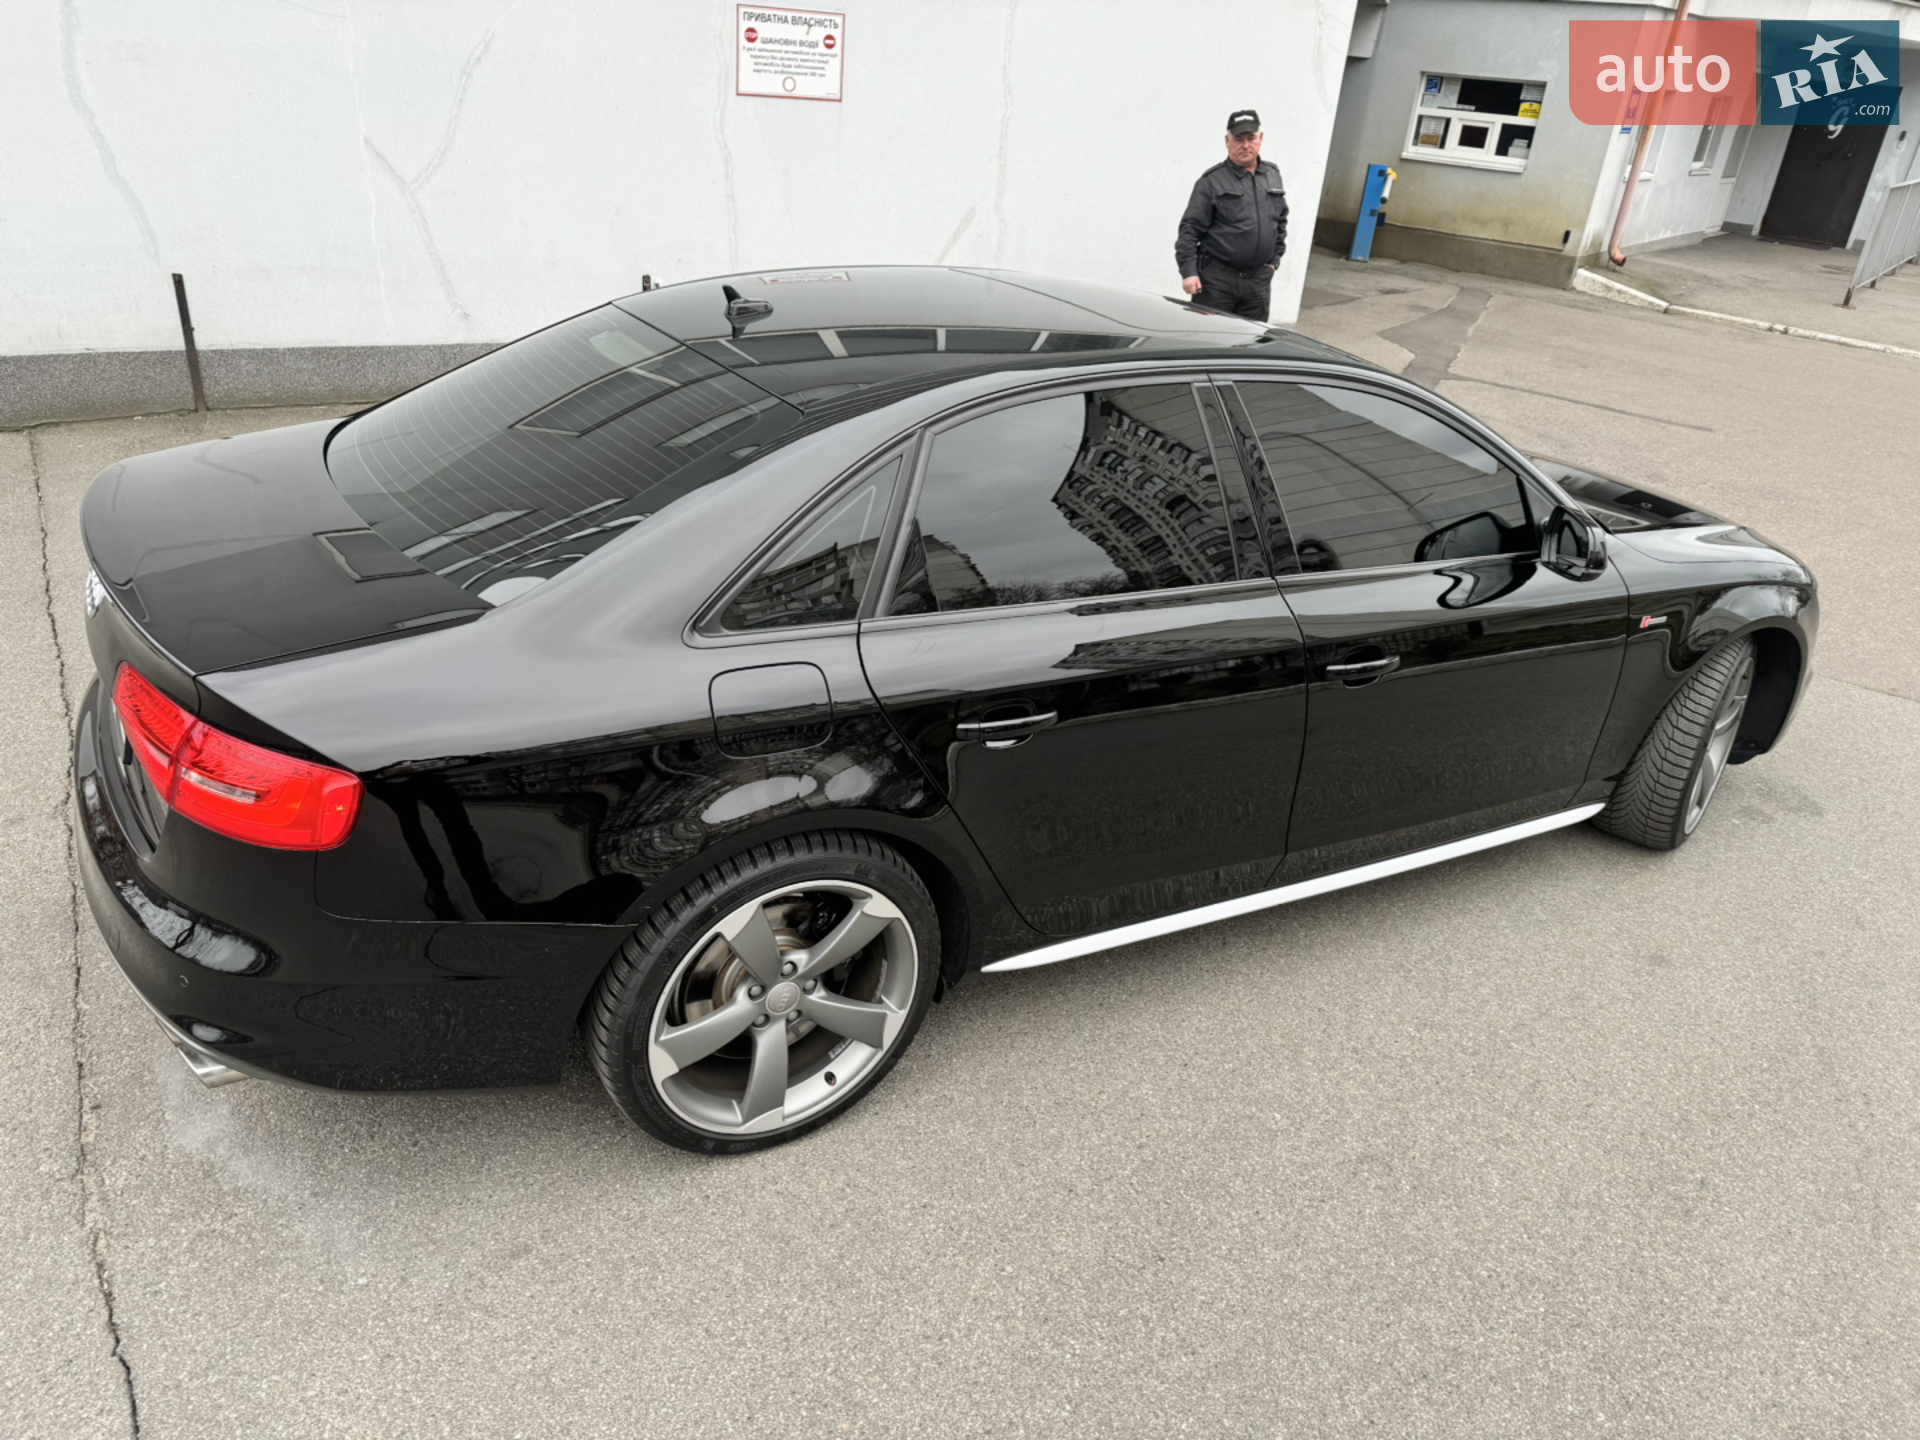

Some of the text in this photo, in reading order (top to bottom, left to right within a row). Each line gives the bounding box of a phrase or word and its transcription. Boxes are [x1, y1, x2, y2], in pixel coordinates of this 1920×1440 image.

[743, 11, 839, 29] ПРИВАТНА ВЛАСНІСТЬ
[760, 37, 820, 49] ШАНОВНІ ВОДІЇ
